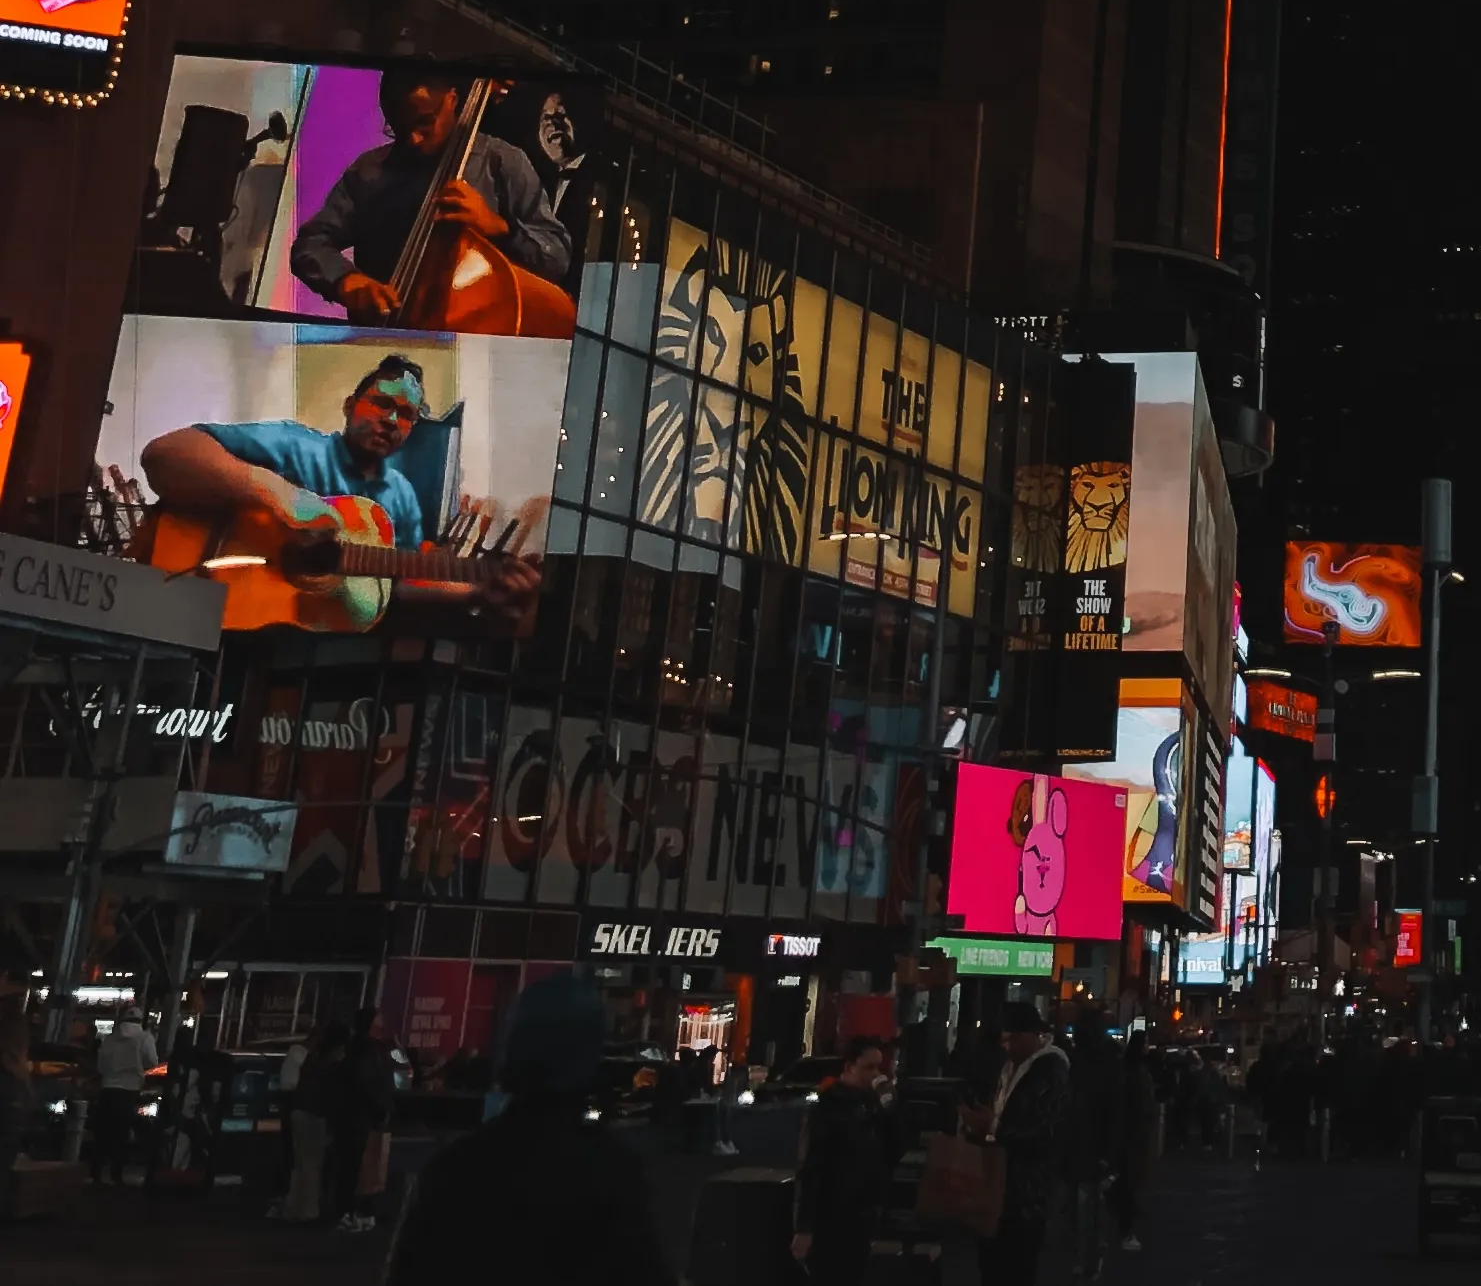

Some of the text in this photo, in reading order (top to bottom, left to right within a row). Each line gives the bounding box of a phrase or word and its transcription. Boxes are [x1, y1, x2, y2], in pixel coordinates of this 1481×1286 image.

[63, 33, 109, 52] SOON
[881, 367, 926, 432] THE
[13, 555, 118, 612] CANE'S
[1083, 579, 1106, 597] THE
[1076, 597, 1112, 615] SHOW
[1079, 615, 1105, 633] OF A
[1064, 633, 1118, 651] LIFETIME
[782, 935, 822, 957] TISSOT
